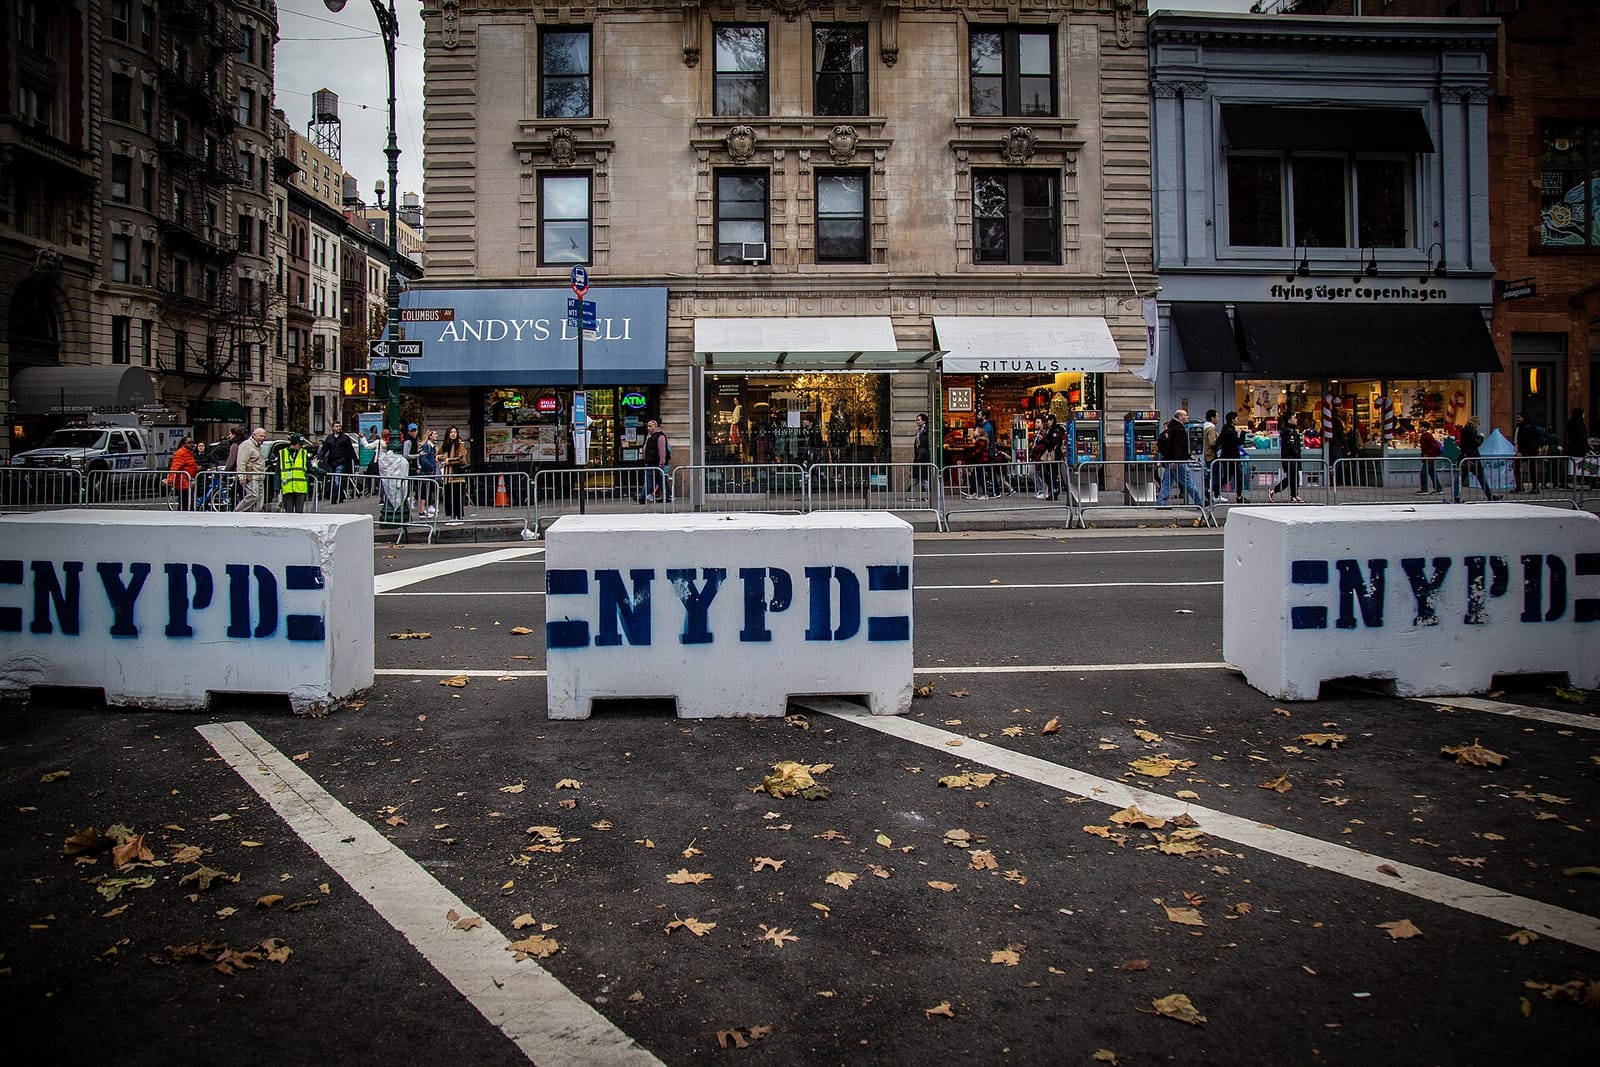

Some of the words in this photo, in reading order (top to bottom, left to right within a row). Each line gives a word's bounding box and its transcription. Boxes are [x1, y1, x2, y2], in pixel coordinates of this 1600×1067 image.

[1270, 285, 1313, 300] flying
[1315, 285, 1352, 300] tiger
[1355, 286, 1447, 301] copenhagen
[401, 310, 440, 321] COLUMBUS
[437, 319, 550, 342] ANDY'S
[560, 318, 633, 341] DLI
[377, 345, 389, 353] ON
[399, 345, 416, 353] WAY
[979, 360, 1085, 371] RITUALS...
[621, 396, 647, 406] ATM
[30, 560, 278, 638] NYPD
[1335, 554, 1567, 628] NYPD
[593, 566, 861, 647] NYPD
